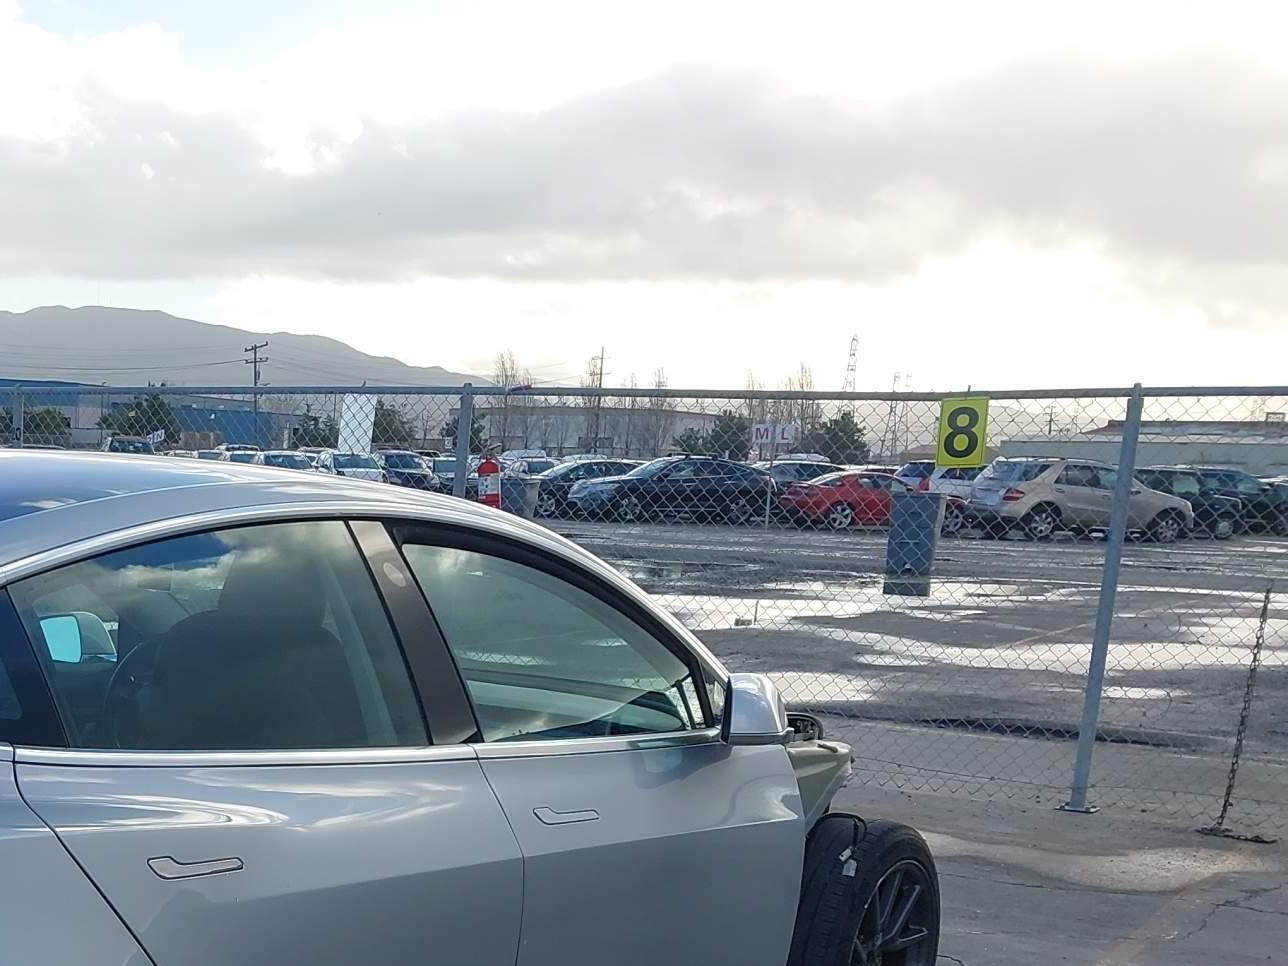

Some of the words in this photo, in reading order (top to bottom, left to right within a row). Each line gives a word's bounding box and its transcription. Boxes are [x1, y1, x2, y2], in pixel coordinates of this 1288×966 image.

[755, 427, 769, 440] M
[781, 427, 790, 440] L
[943, 406, 979, 458] 8
